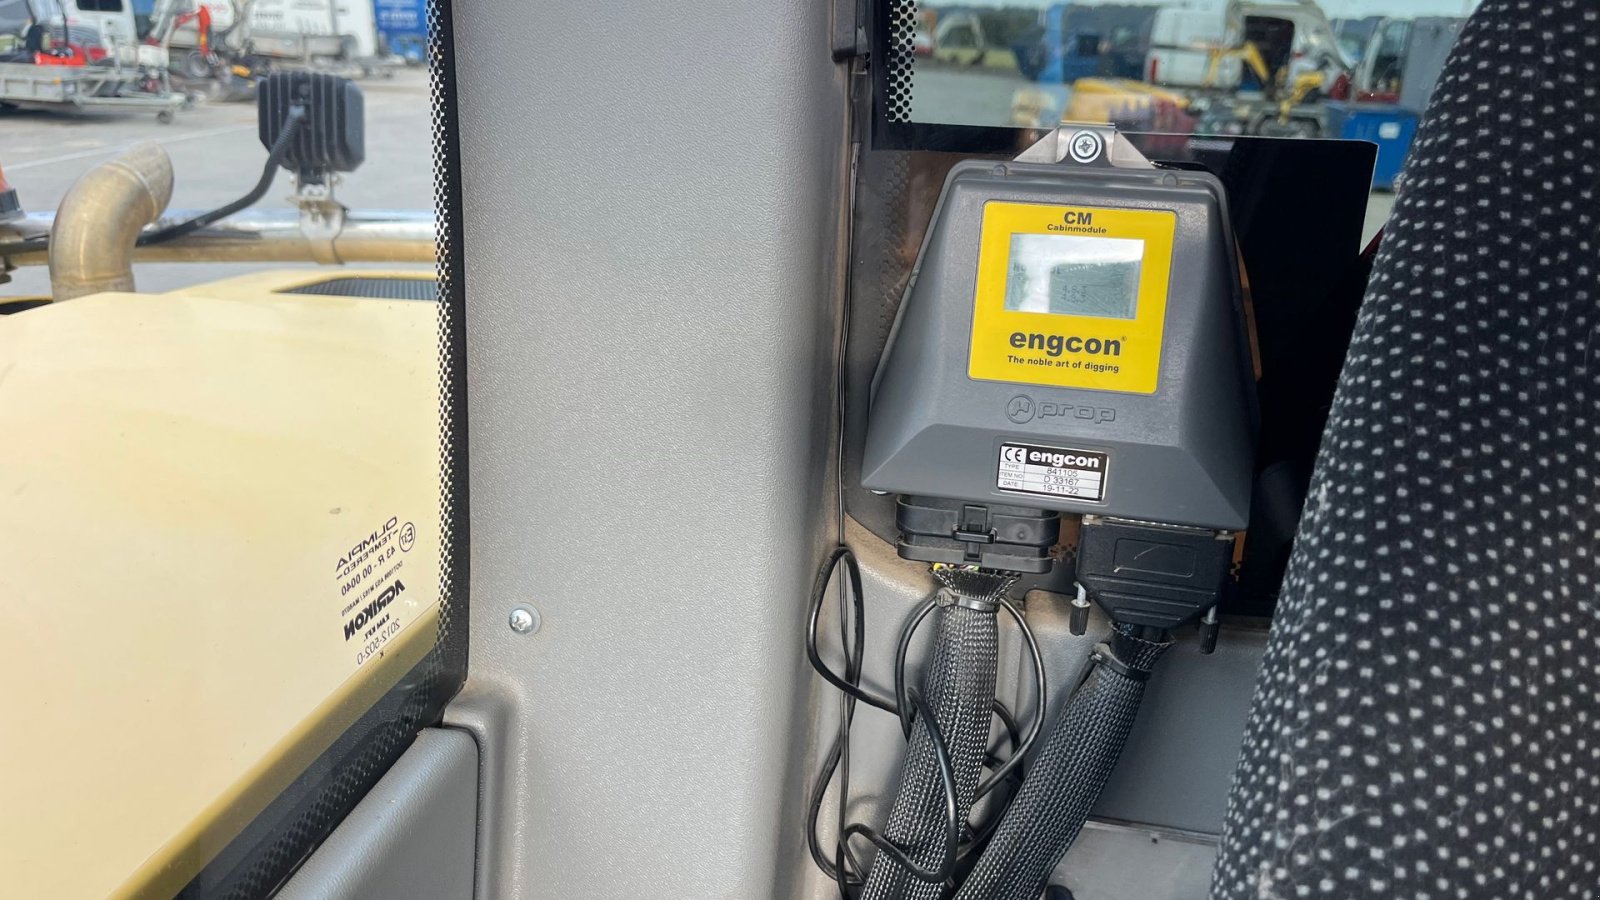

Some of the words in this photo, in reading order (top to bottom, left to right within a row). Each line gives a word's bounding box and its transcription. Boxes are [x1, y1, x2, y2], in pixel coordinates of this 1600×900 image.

[1063, 211, 1092, 225] CM
[1047, 223, 1107, 234] Cabinmodule
[1009, 331, 1121, 357] engcon
[1007, 355, 1024, 364] The
[1027, 358, 1053, 367] noble
[1056, 360, 1069, 368] art
[1072, 361, 1082, 369] of
[1085, 362, 1119, 374] digging
[1029, 450, 1099, 468] engcon
[1046, 467, 1078, 478] 841105
[1043, 475, 1050, 483] D
[1053, 476, 1079, 486] 33167
[1042, 484, 1079, 495] 19-11-22
